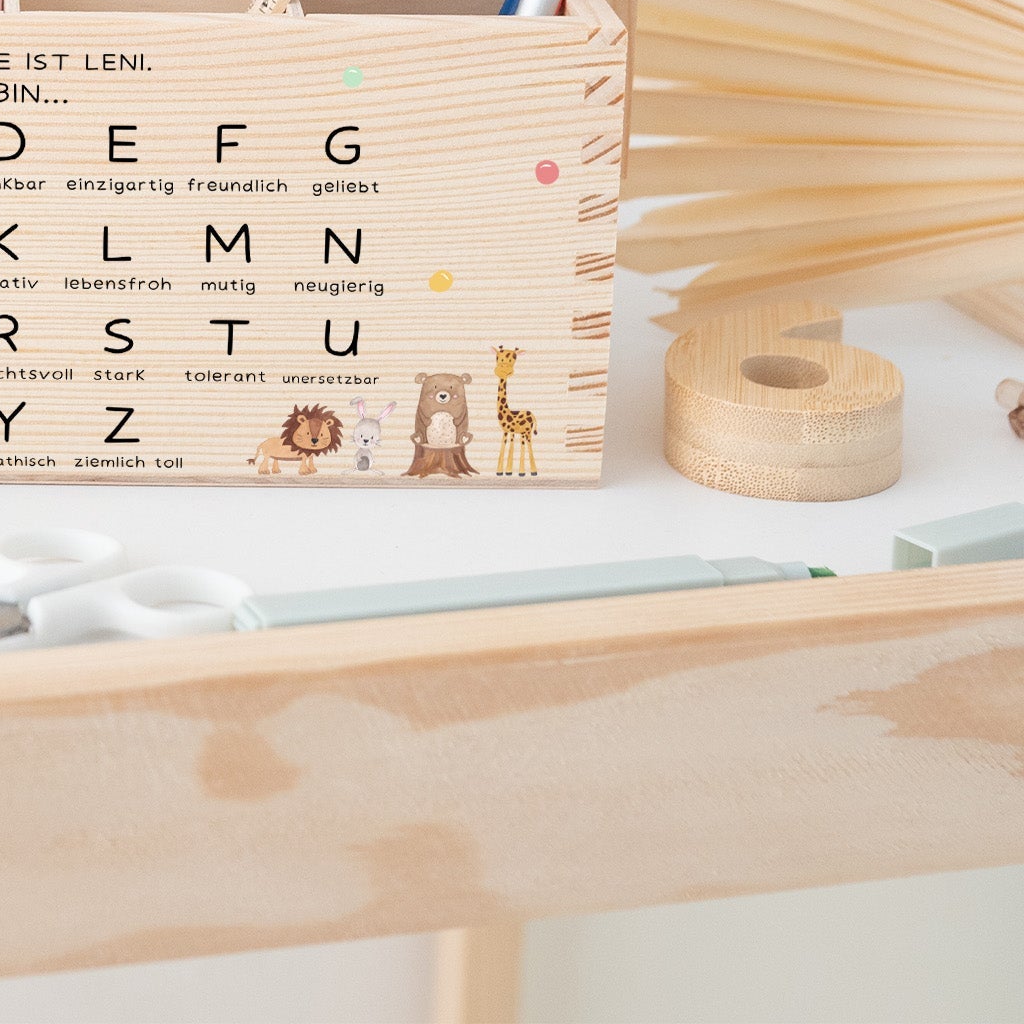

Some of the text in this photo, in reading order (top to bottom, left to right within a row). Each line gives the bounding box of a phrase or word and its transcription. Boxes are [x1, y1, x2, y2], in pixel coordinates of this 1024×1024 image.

[26, 52, 70, 71] IST
[85, 53, 152, 72] LENI.
[108, 124, 139, 163] E
[216, 124, 248, 164] F
[324, 125, 361, 165] G
[66, 177, 174, 196] einzigartig
[187, 177, 288, 193] freundlich
[312, 179, 379, 197] geliebt
[102, 225, 132, 262] L
[205, 223, 252, 264] M
[324, 227, 362, 265] N
[64, 277, 172, 291] lebensfroh
[201, 279, 256, 296] mutig
[294, 279, 384, 297] neugierig
[103, 318, 134, 354] S
[209, 319, 250, 356] T
[324, 319, 360, 357] U
[184, 370, 266, 383] tolerant
[282, 375, 380, 385] unersetzbar
[103, 406, 141, 444] Z
[74, 455, 145, 468] ziemlich
[154, 457, 183, 469] toll
